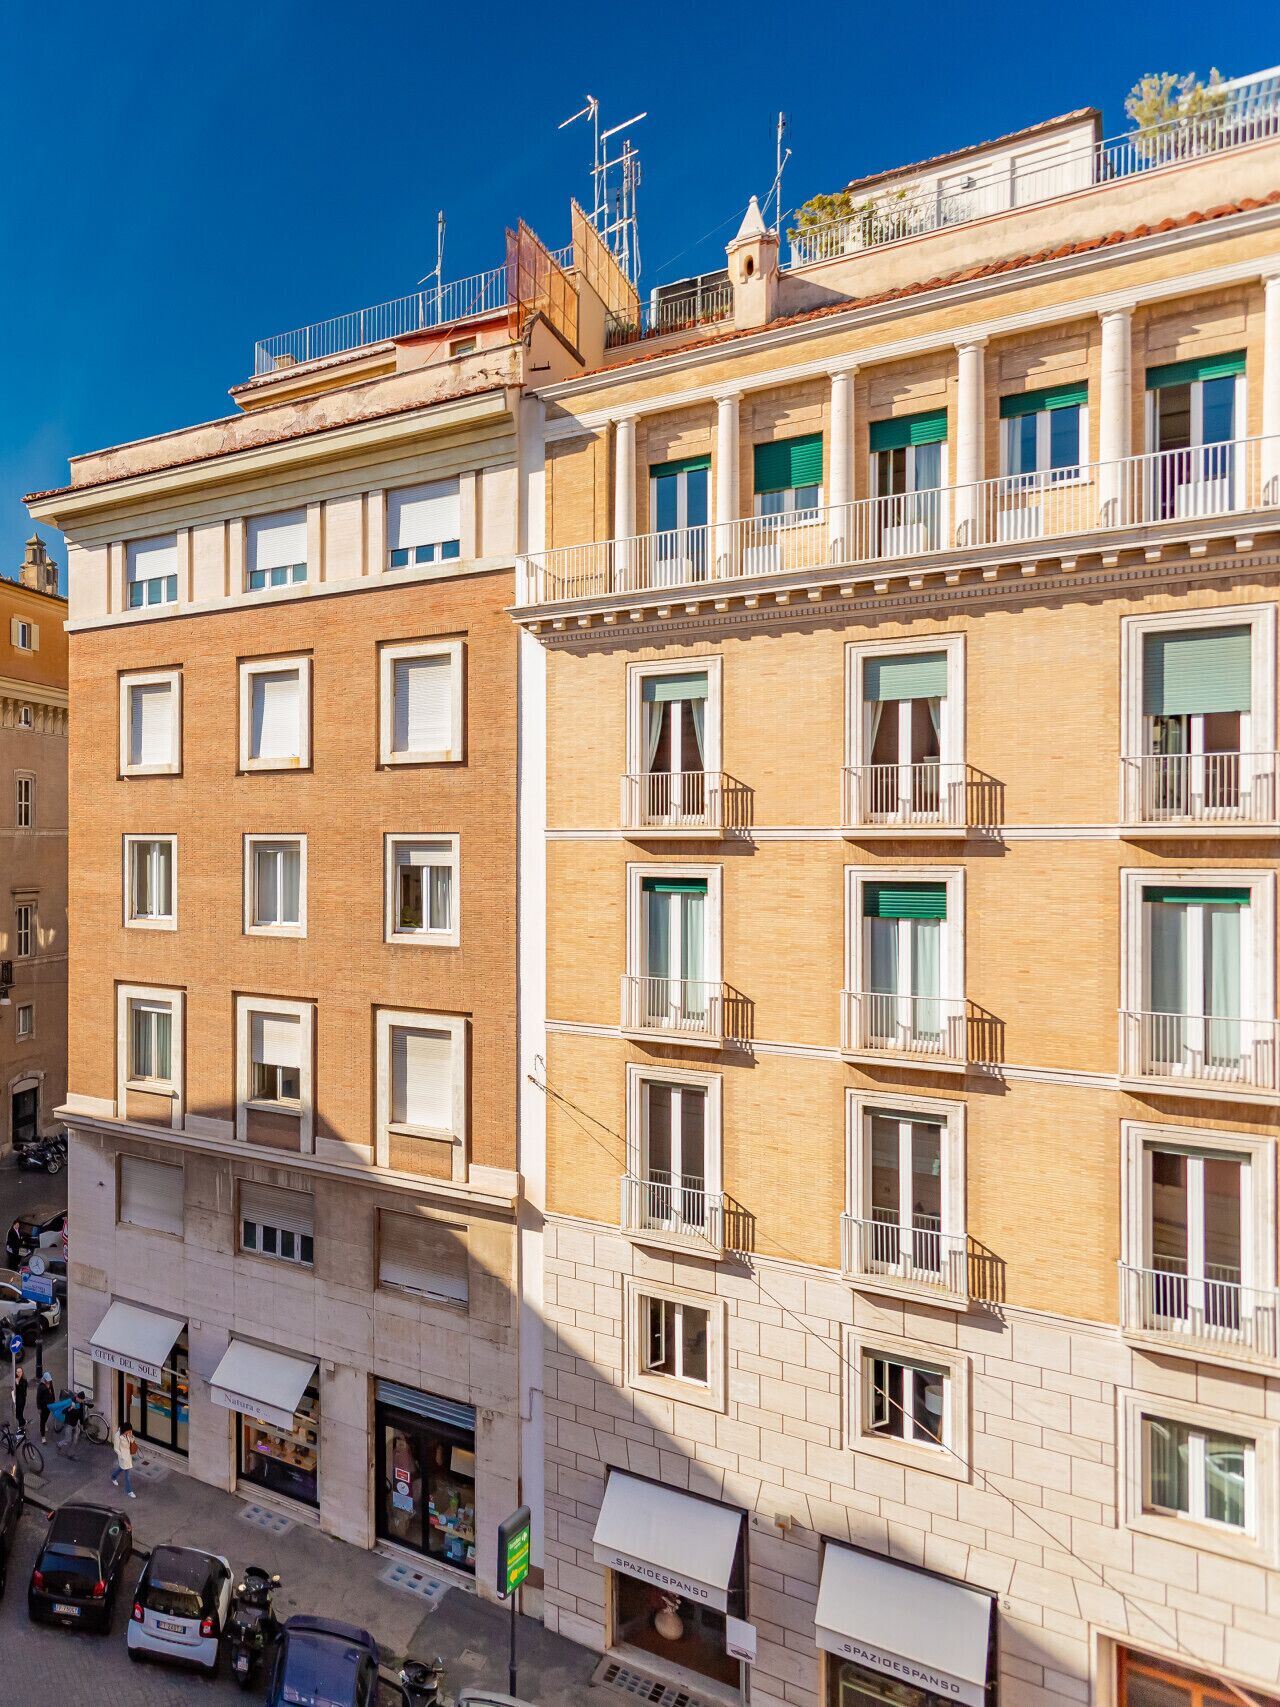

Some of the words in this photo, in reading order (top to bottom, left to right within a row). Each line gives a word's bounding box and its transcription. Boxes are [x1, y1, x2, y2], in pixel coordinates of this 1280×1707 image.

[120, 1359, 134, 1370] DEL
[138, 1364, 158, 1378] SOLE
[224, 1393, 254, 1412] Natura
[751, 1517, 759, 1526] 4
[1003, 1600, 1011, 1610] 5
